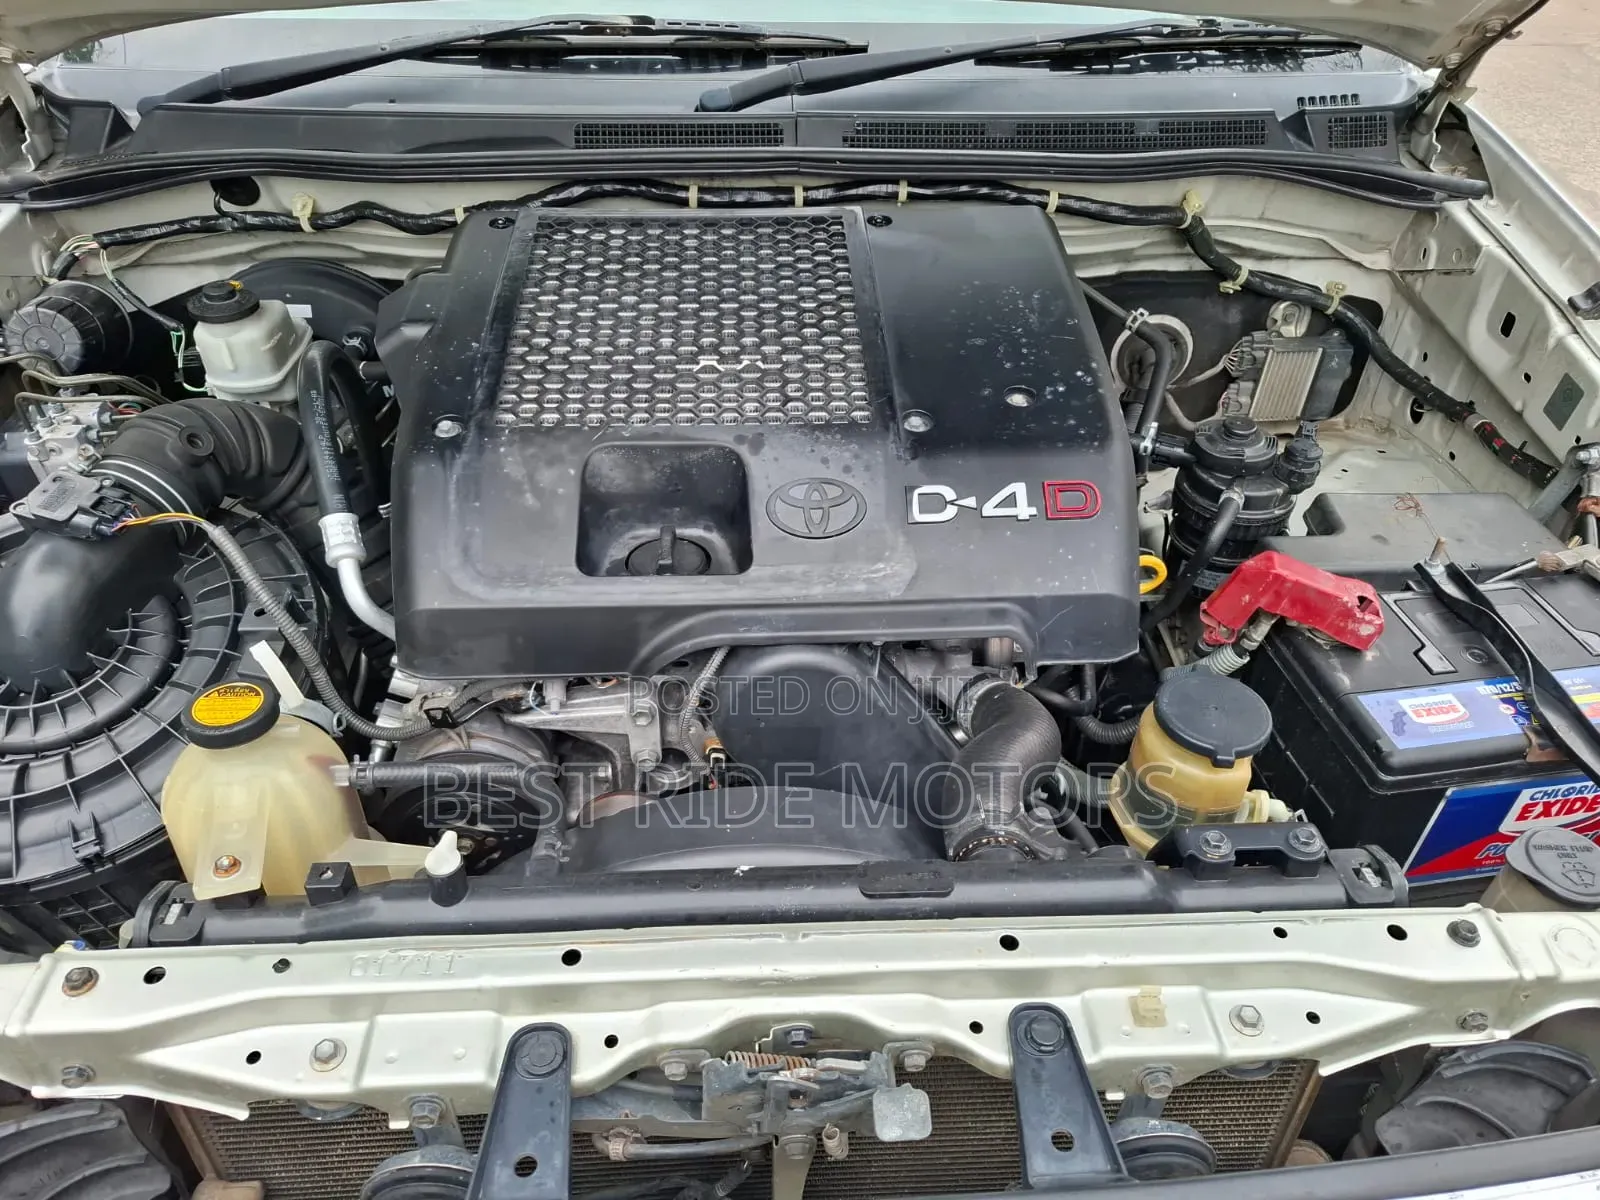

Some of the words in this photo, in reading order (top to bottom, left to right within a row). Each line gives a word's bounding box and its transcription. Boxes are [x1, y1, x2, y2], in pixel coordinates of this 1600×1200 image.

[905, 480, 1102, 524] D-4D
[1410, 704, 1461, 718] EXIDE
[1515, 794, 1600, 822] EXIDE
